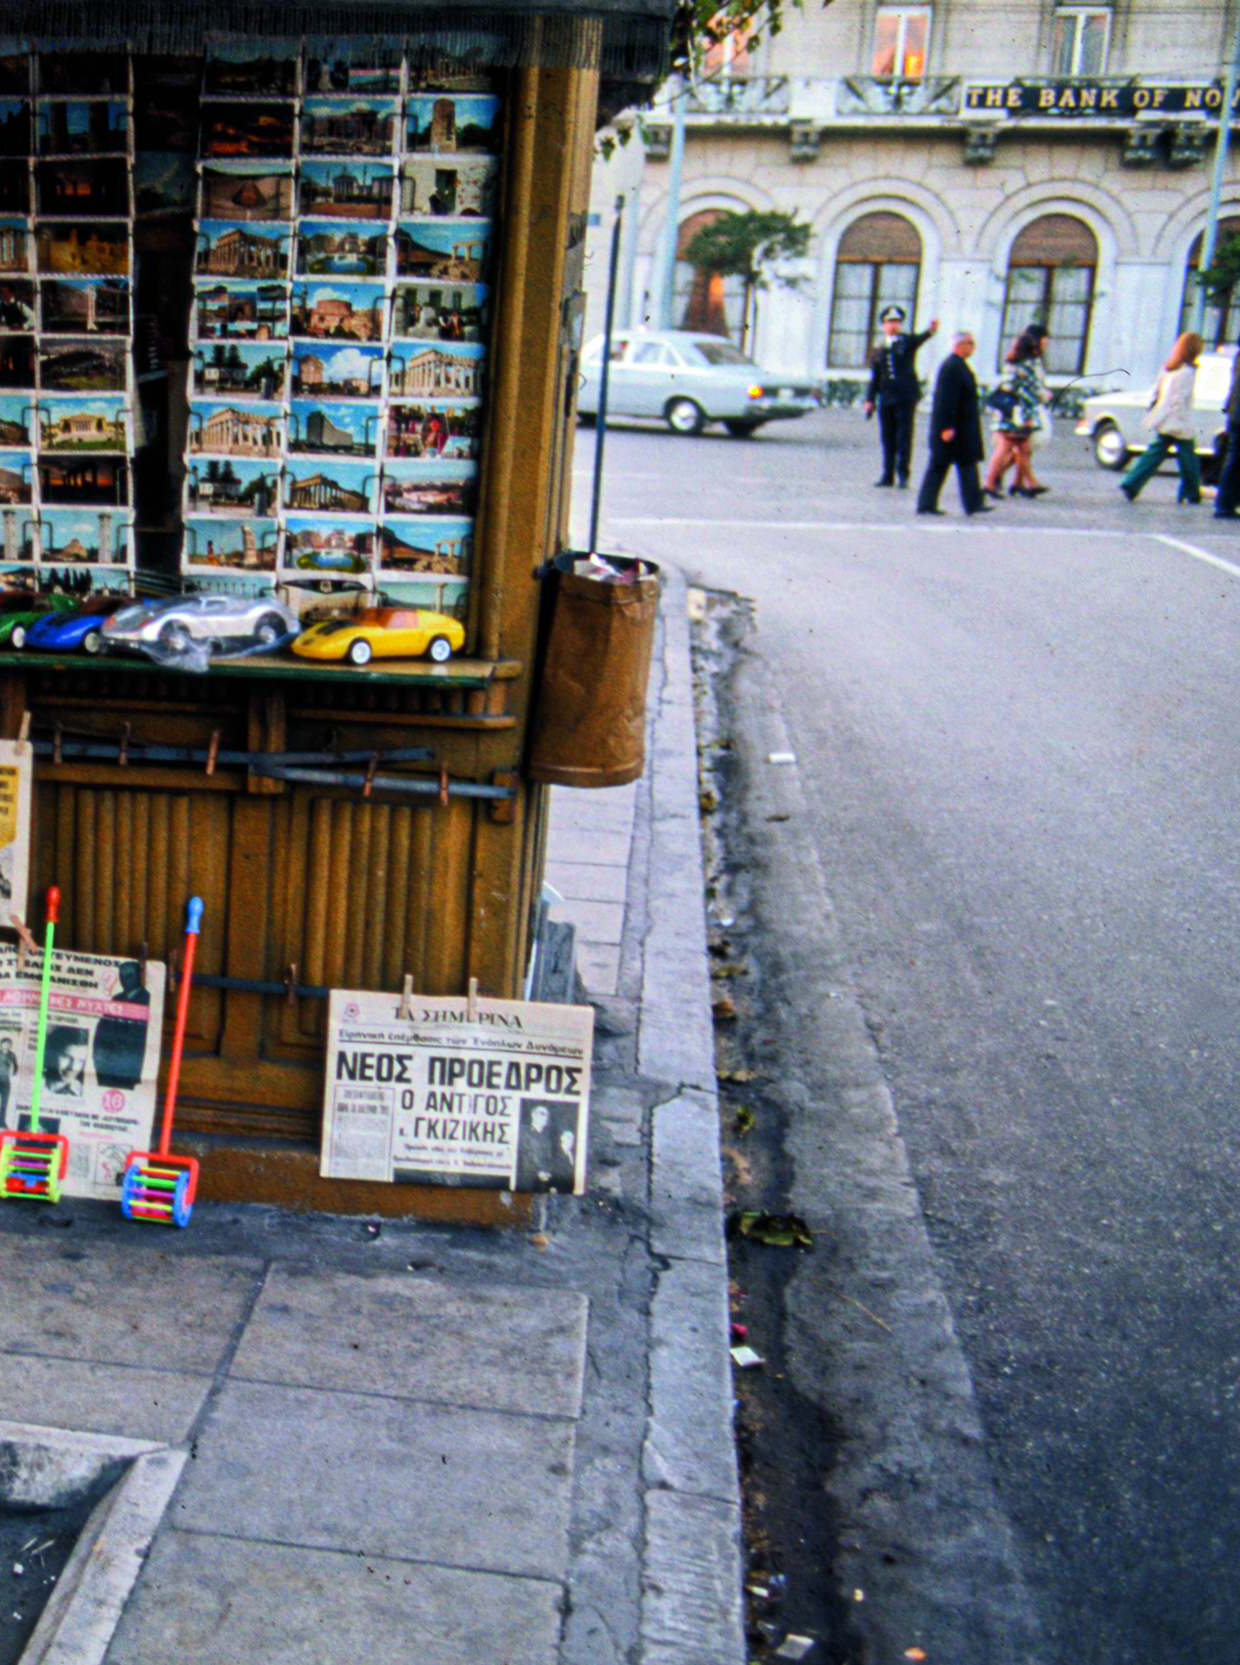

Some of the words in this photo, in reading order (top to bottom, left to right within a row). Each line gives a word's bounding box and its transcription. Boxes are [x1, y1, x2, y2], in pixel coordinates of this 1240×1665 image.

[967, 87, 1023, 108] THE
[1038, 87, 1121, 108] BANK
[1133, 88, 1169, 108] OF
[336, 1050, 413, 1084] ΝΕΟΣ
[428, 1056, 583, 1096] ΠΡΟΕΔΡΟΣ
[401, 1089, 415, 1111] Ο
[414, 1117, 511, 1145] ΓΚΙΖΙΚΗΣ
